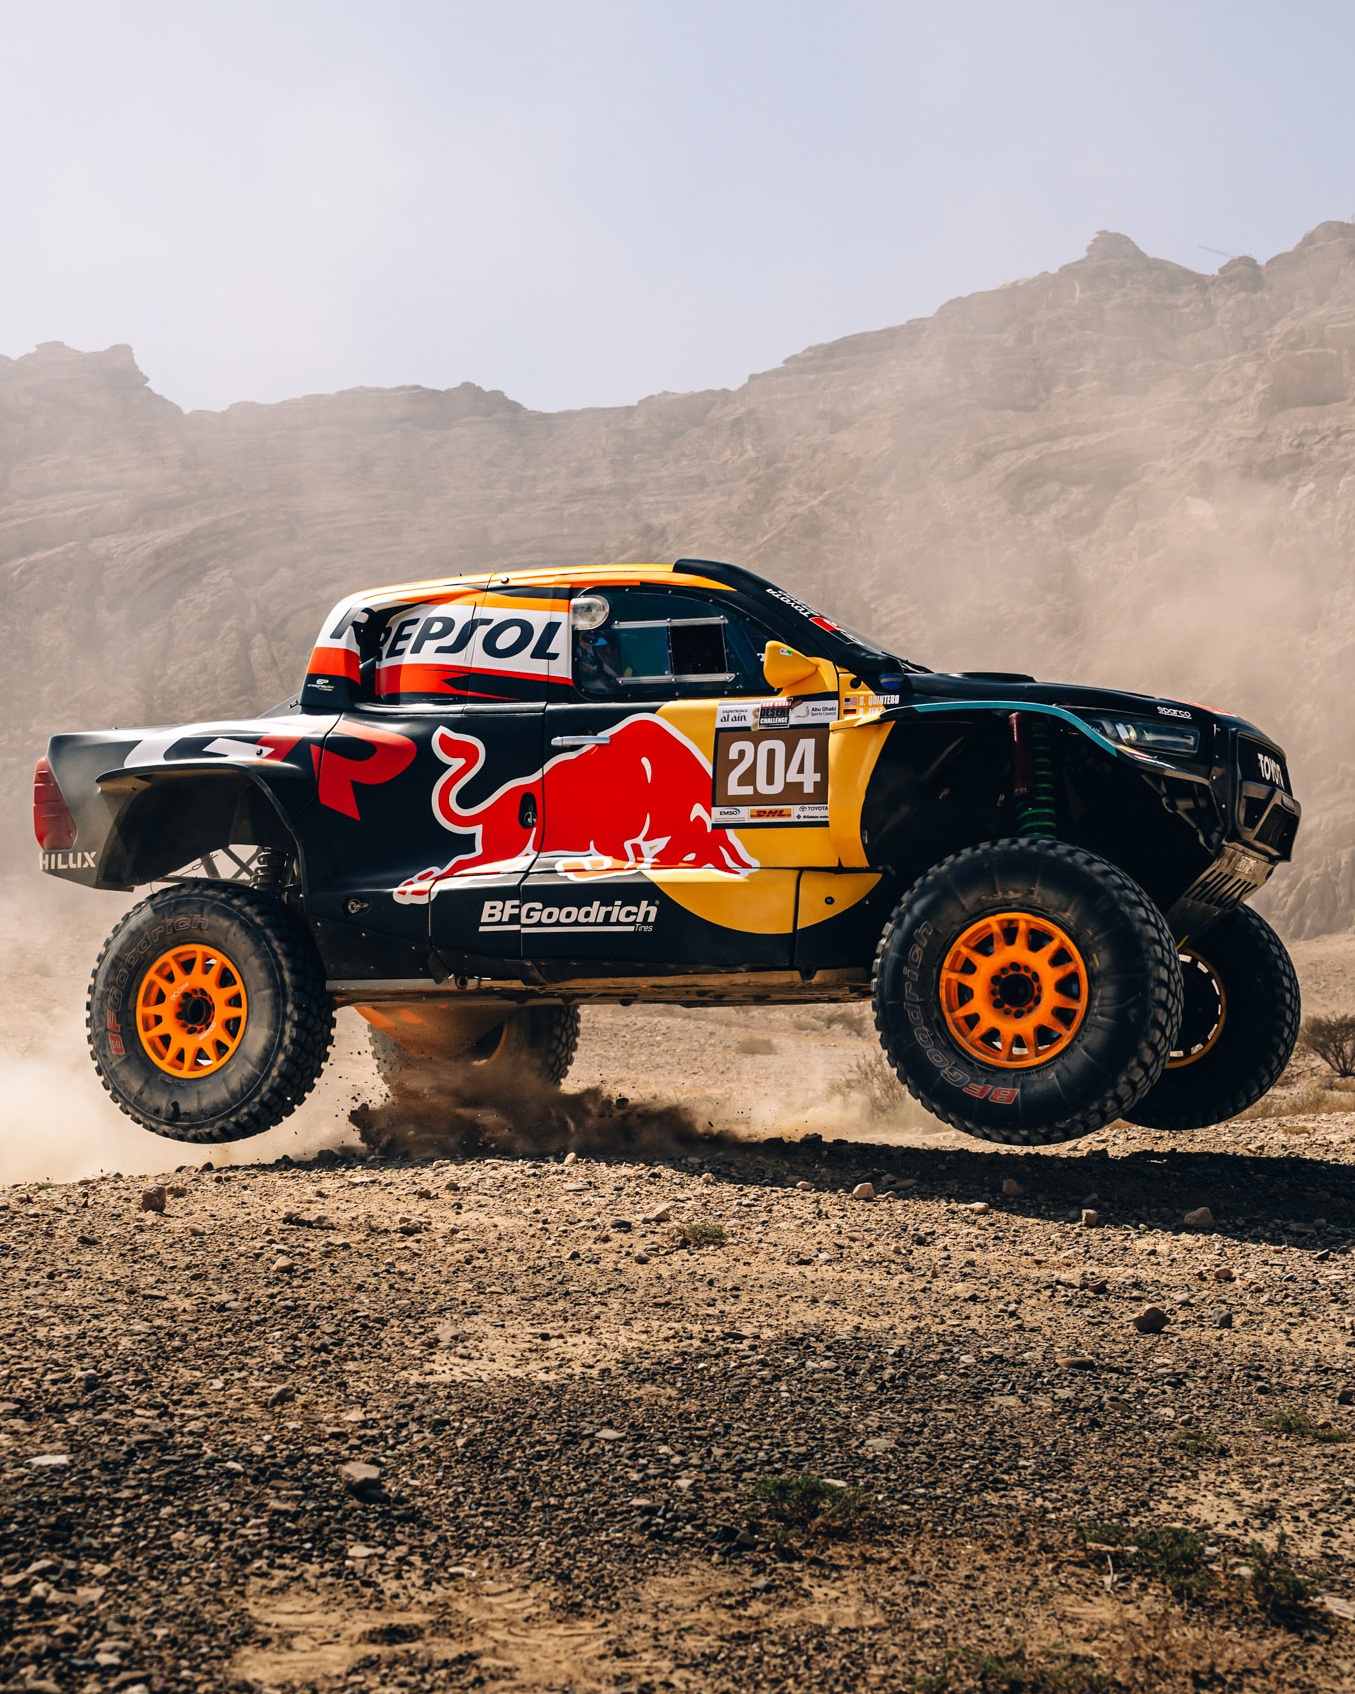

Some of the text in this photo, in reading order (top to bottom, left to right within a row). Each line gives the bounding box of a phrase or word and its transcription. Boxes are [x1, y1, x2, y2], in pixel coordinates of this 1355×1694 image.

[868, 694, 900, 706] QUINTERO
[720, 713, 747, 723] al ain
[1157, 706, 1192, 719] sparco
[727, 738, 821, 796] 204
[755, 809, 786, 818] DHL
[39, 851, 97, 871] HILUX
[1184, 869, 1258, 910] HILUX
[480, 900, 658, 924] BFGoodrich
[634, 924, 653, 932] Tires
[903, 920, 1020, 1106] BFGoodrich
